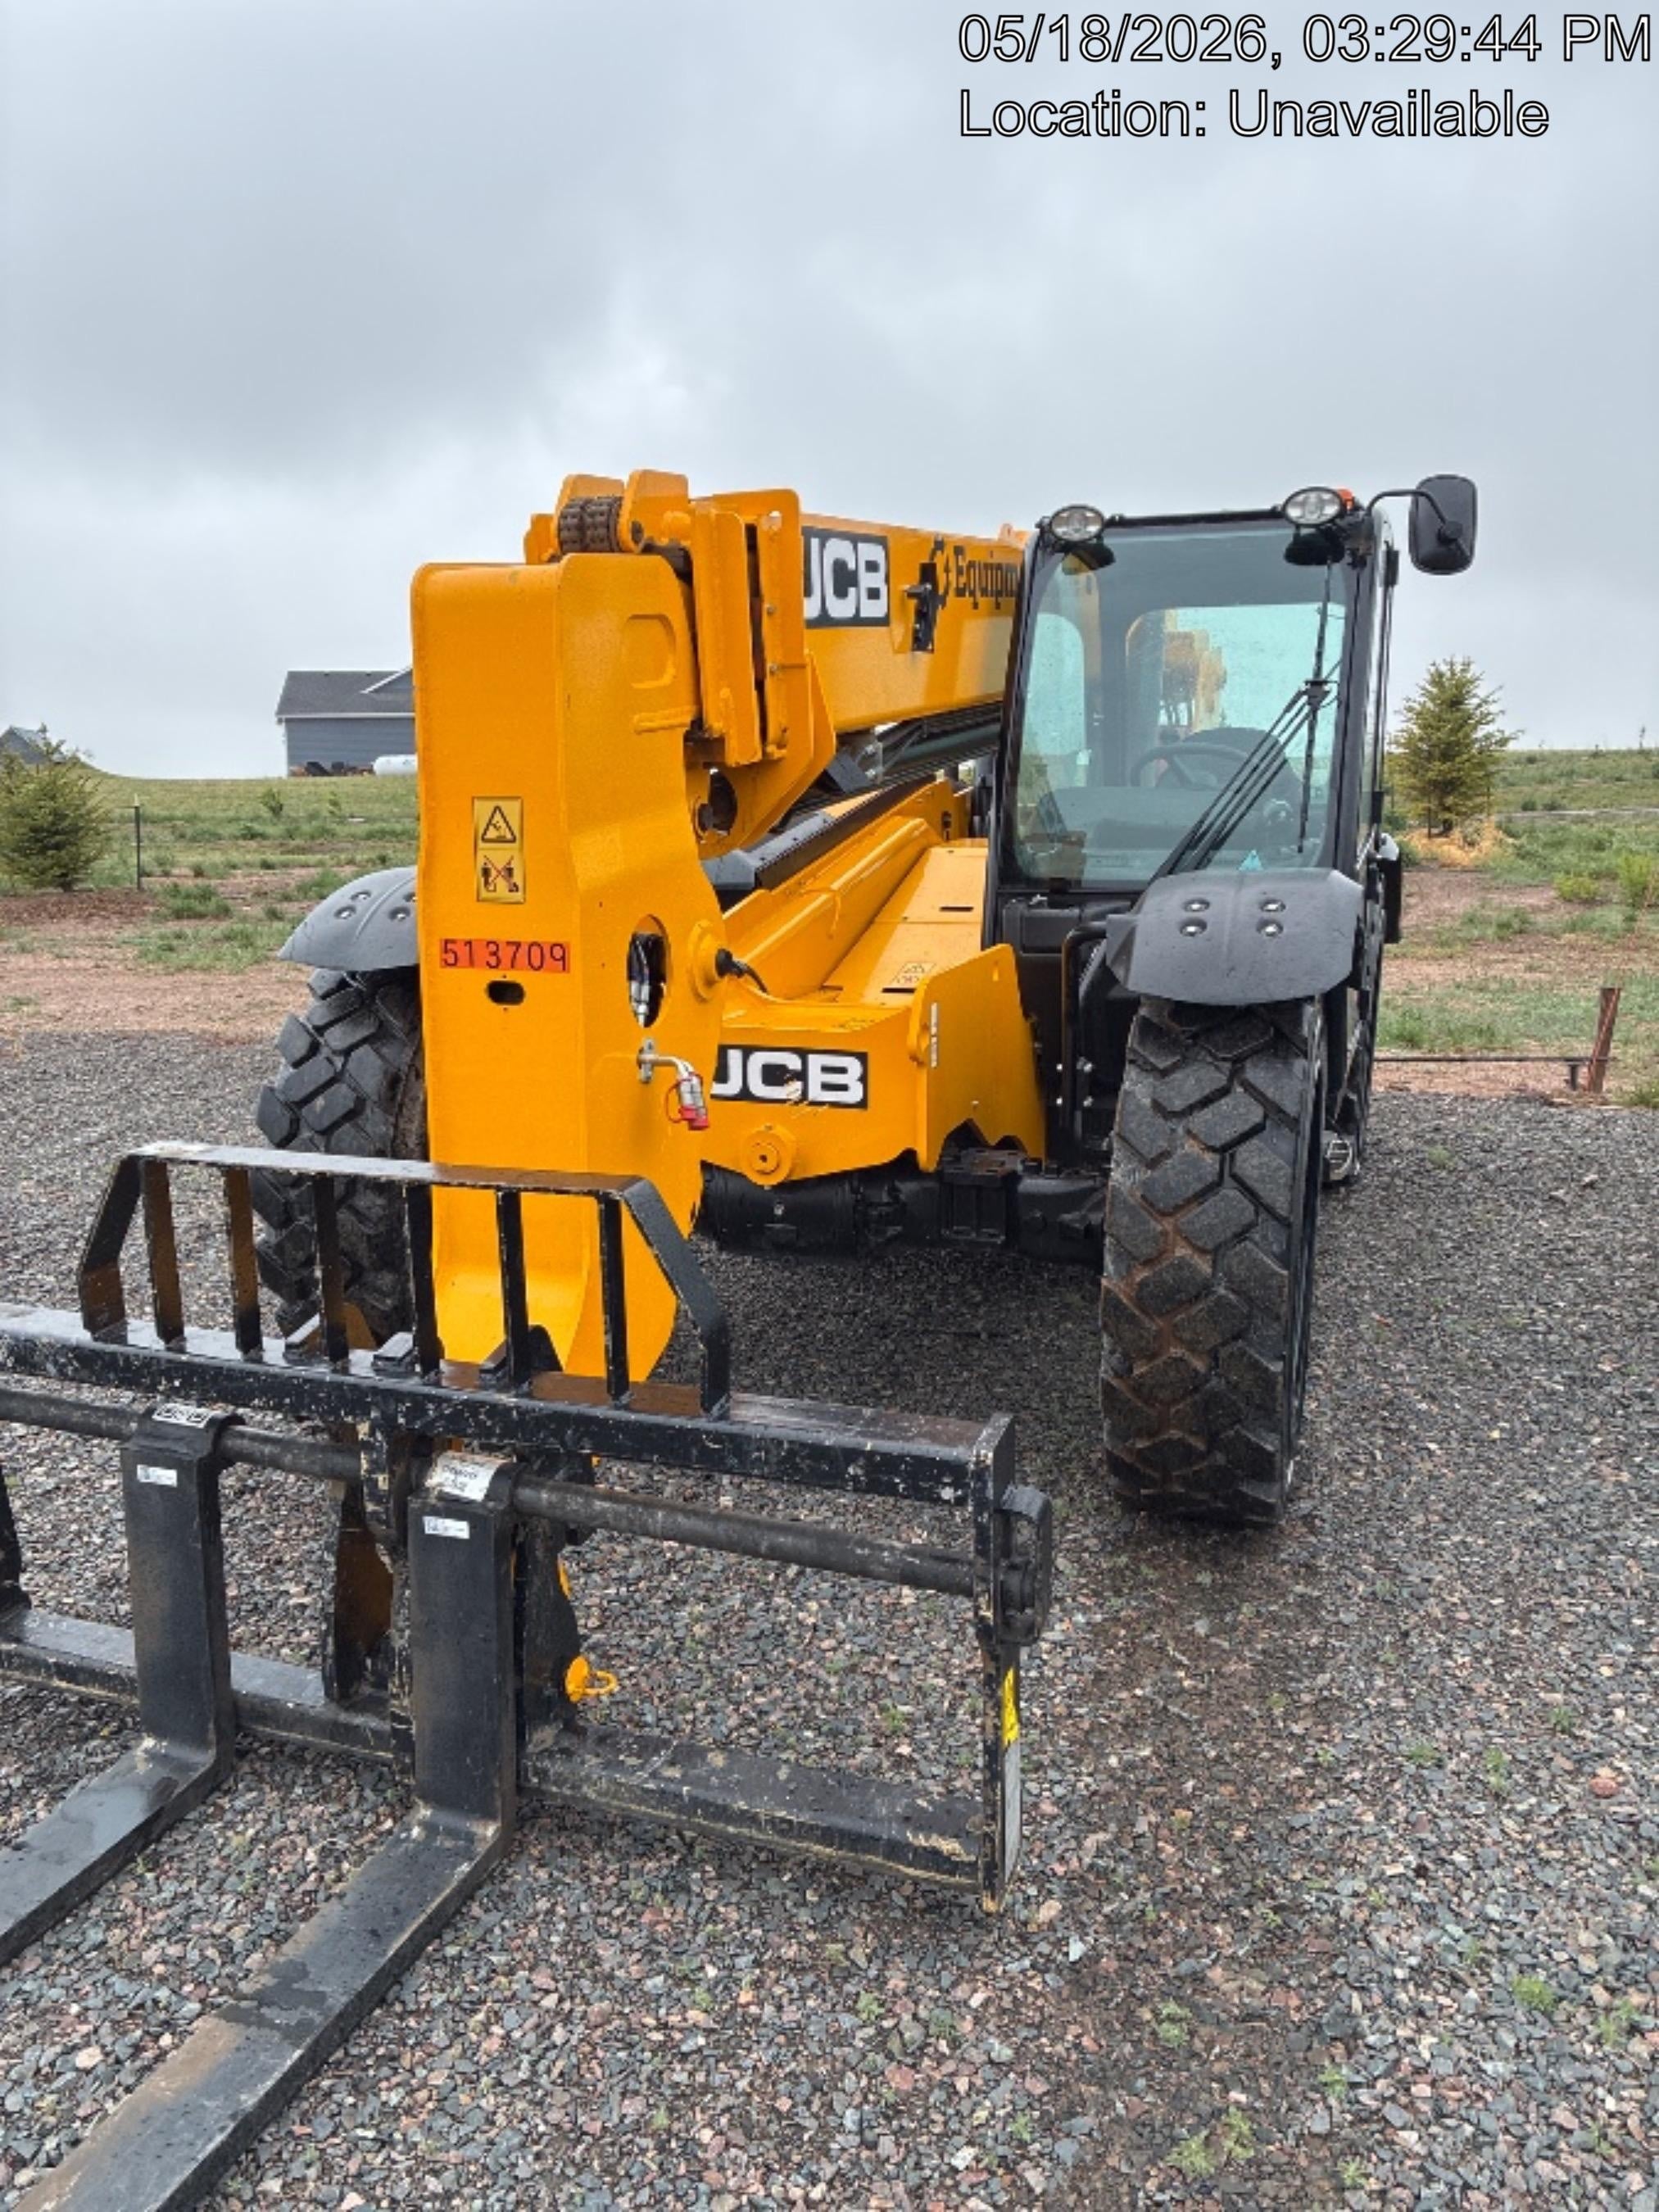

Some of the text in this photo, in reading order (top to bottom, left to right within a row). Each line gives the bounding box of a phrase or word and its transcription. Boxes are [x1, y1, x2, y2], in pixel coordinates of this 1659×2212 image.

[804, 537, 887, 619] JCB
[443, 939, 567, 972] 513709
[710, 1049, 863, 1104] JCB
